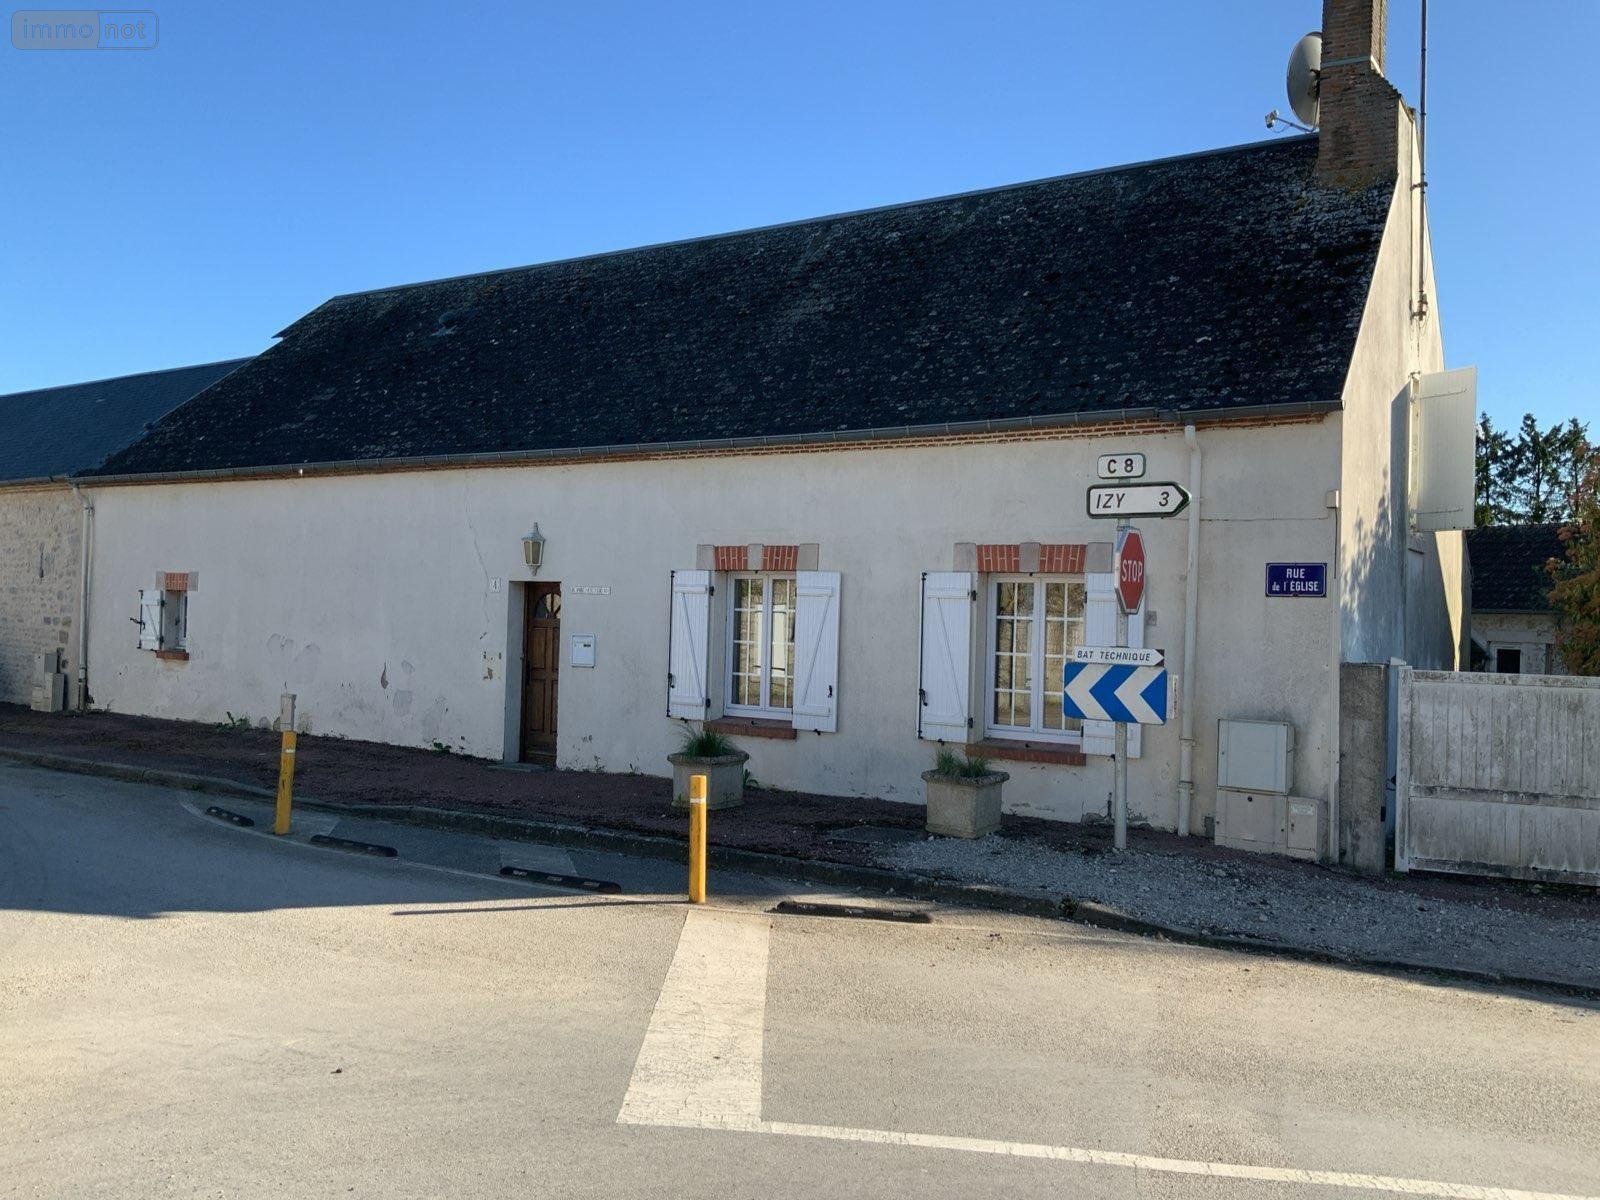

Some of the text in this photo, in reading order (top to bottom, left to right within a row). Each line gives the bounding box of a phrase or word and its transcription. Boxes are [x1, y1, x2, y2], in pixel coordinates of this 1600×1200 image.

[1107, 458, 1134, 474] C 8
[1096, 491, 1170, 509] IZY 3
[1121, 559, 1143, 582] STOP
[1286, 568, 1306, 579] RUE
[1271, 581, 1280, 591] de
[1077, 650, 1151, 661] BAT TECHNIQUE
